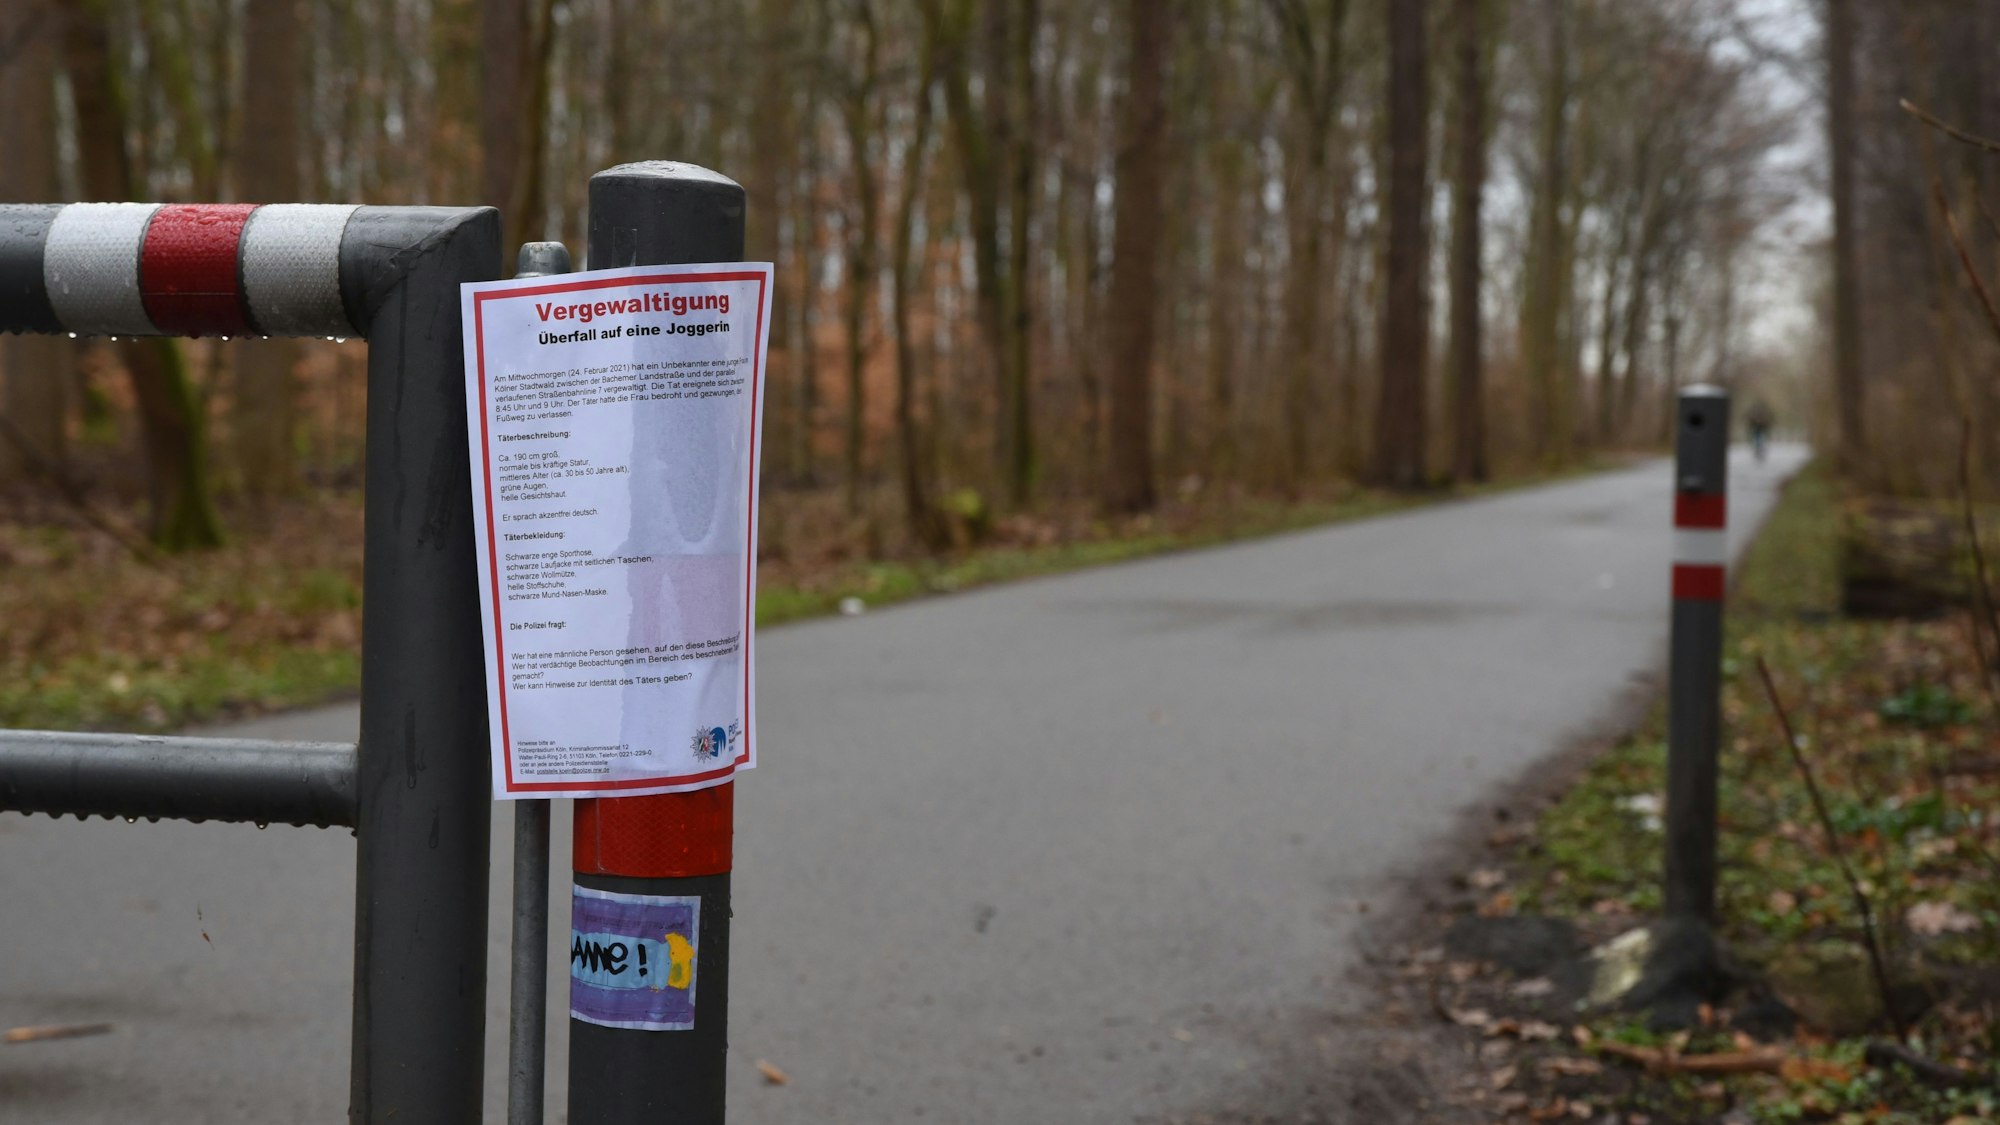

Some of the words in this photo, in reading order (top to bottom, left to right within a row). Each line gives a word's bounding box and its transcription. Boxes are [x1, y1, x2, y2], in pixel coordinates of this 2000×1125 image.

[535, 293, 730, 323] Vergewaltigung
[538, 329, 597, 345] Überfall
[601, 326, 622, 339] auf
[626, 323, 661, 337] eine
[665, 321, 730, 336] Joggerin
[508, 372, 566, 382] Mittwochmorgen
[610, 364, 630, 372] 2021)
[661, 360, 710, 369] Unbekannter
[520, 381, 554, 390] Stadtwald
[556, 379, 588, 388] zwischen
[602, 375, 637, 383] Bachemer
[639, 371, 685, 380] Landstraße
[495, 394, 536, 402] verlaufenen
[538, 388, 596, 399] Straßenbahnlinie
[682, 380, 716, 389] ereignete
[496, 404, 512, 412] 8:45
[528, 402, 542, 410] und
[499, 463, 528, 471] normale
[543, 460, 568, 469] kräftige
[500, 484, 521, 493] grüne
[501, 493, 518, 501] helle
[513, 513, 537, 522] sprach
[539, 510, 570, 519] akzentfrei
[541, 560, 572, 569] Laufjacke
[539, 661, 576, 669] verdächtige
[578, 659, 634, 667] Beobachtungen
[648, 654, 679, 663] Bereich
[512, 672, 544, 681] gemacht?
[664, 672, 692, 684] geben?
